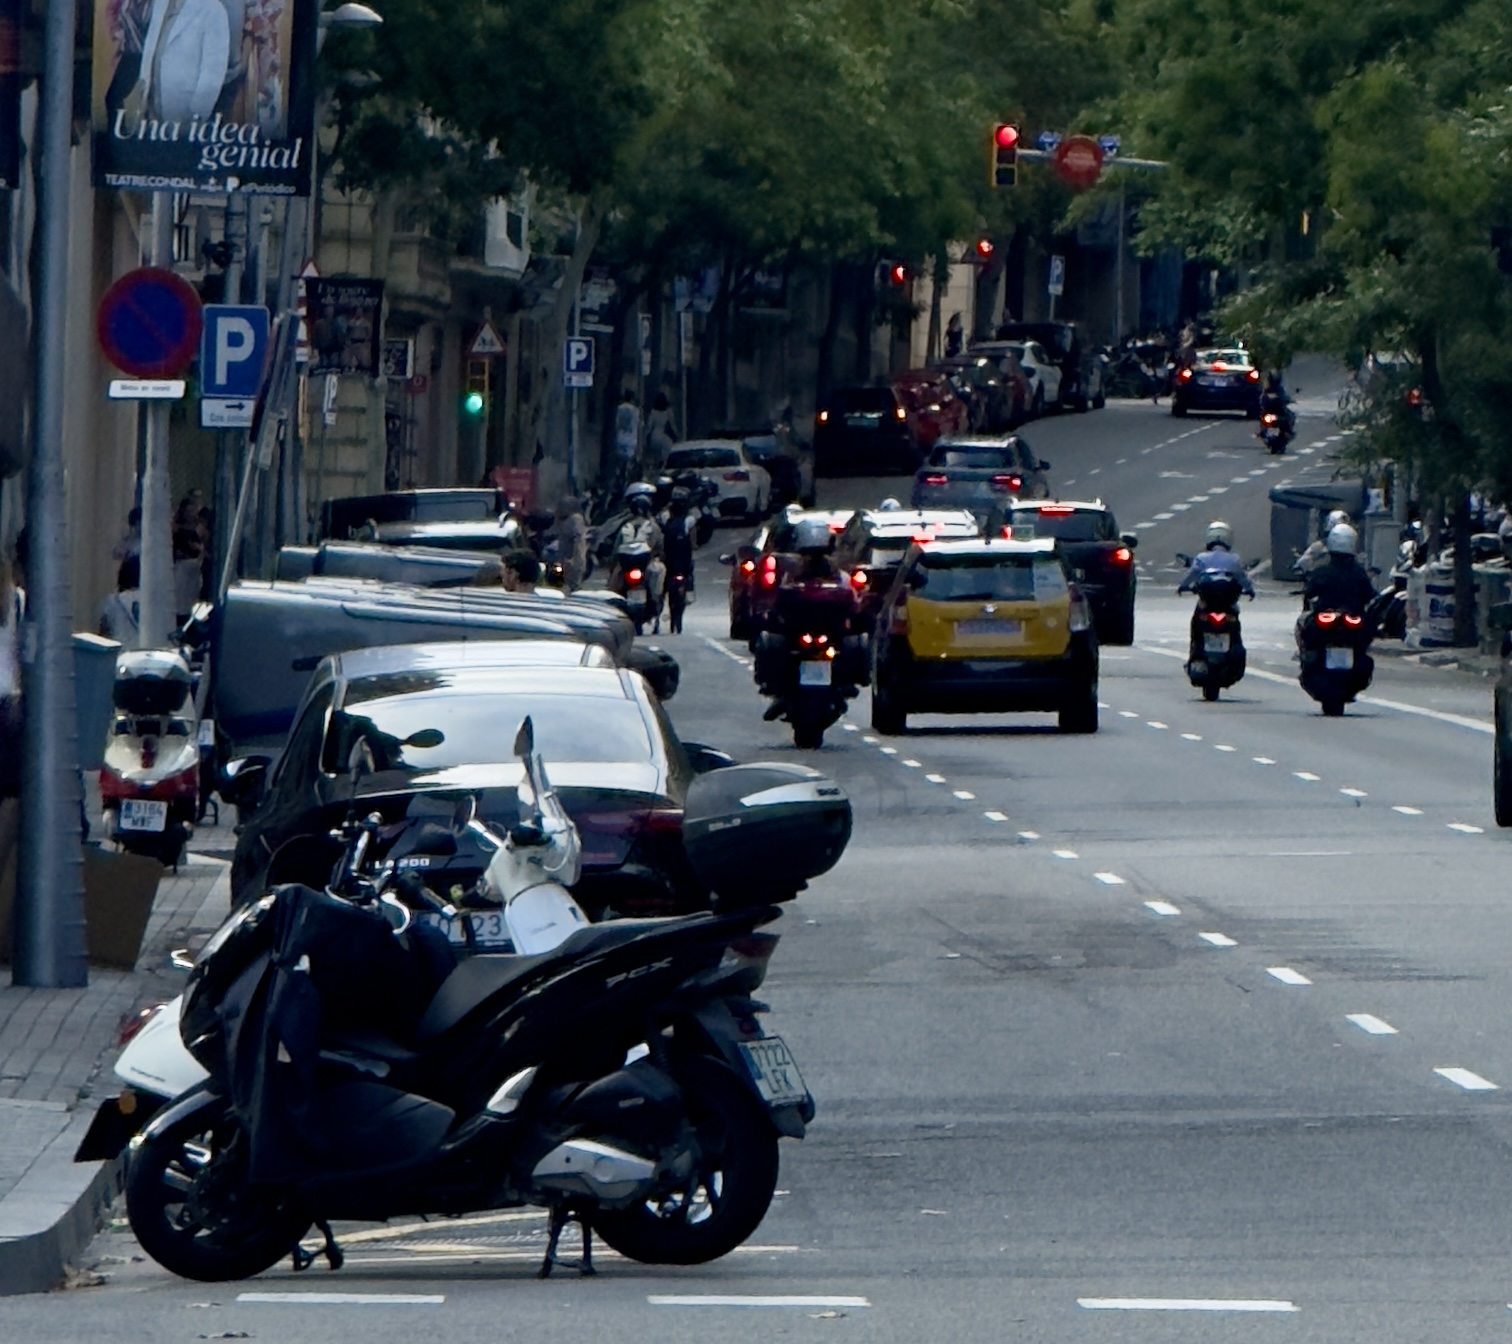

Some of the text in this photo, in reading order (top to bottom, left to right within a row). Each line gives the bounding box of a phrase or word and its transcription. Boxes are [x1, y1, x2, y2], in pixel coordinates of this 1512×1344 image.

[114, 108, 259, 145] Una idea
[197, 136, 303, 171] genial
[215, 316, 256, 386] P
[569, 340, 589, 371] P
